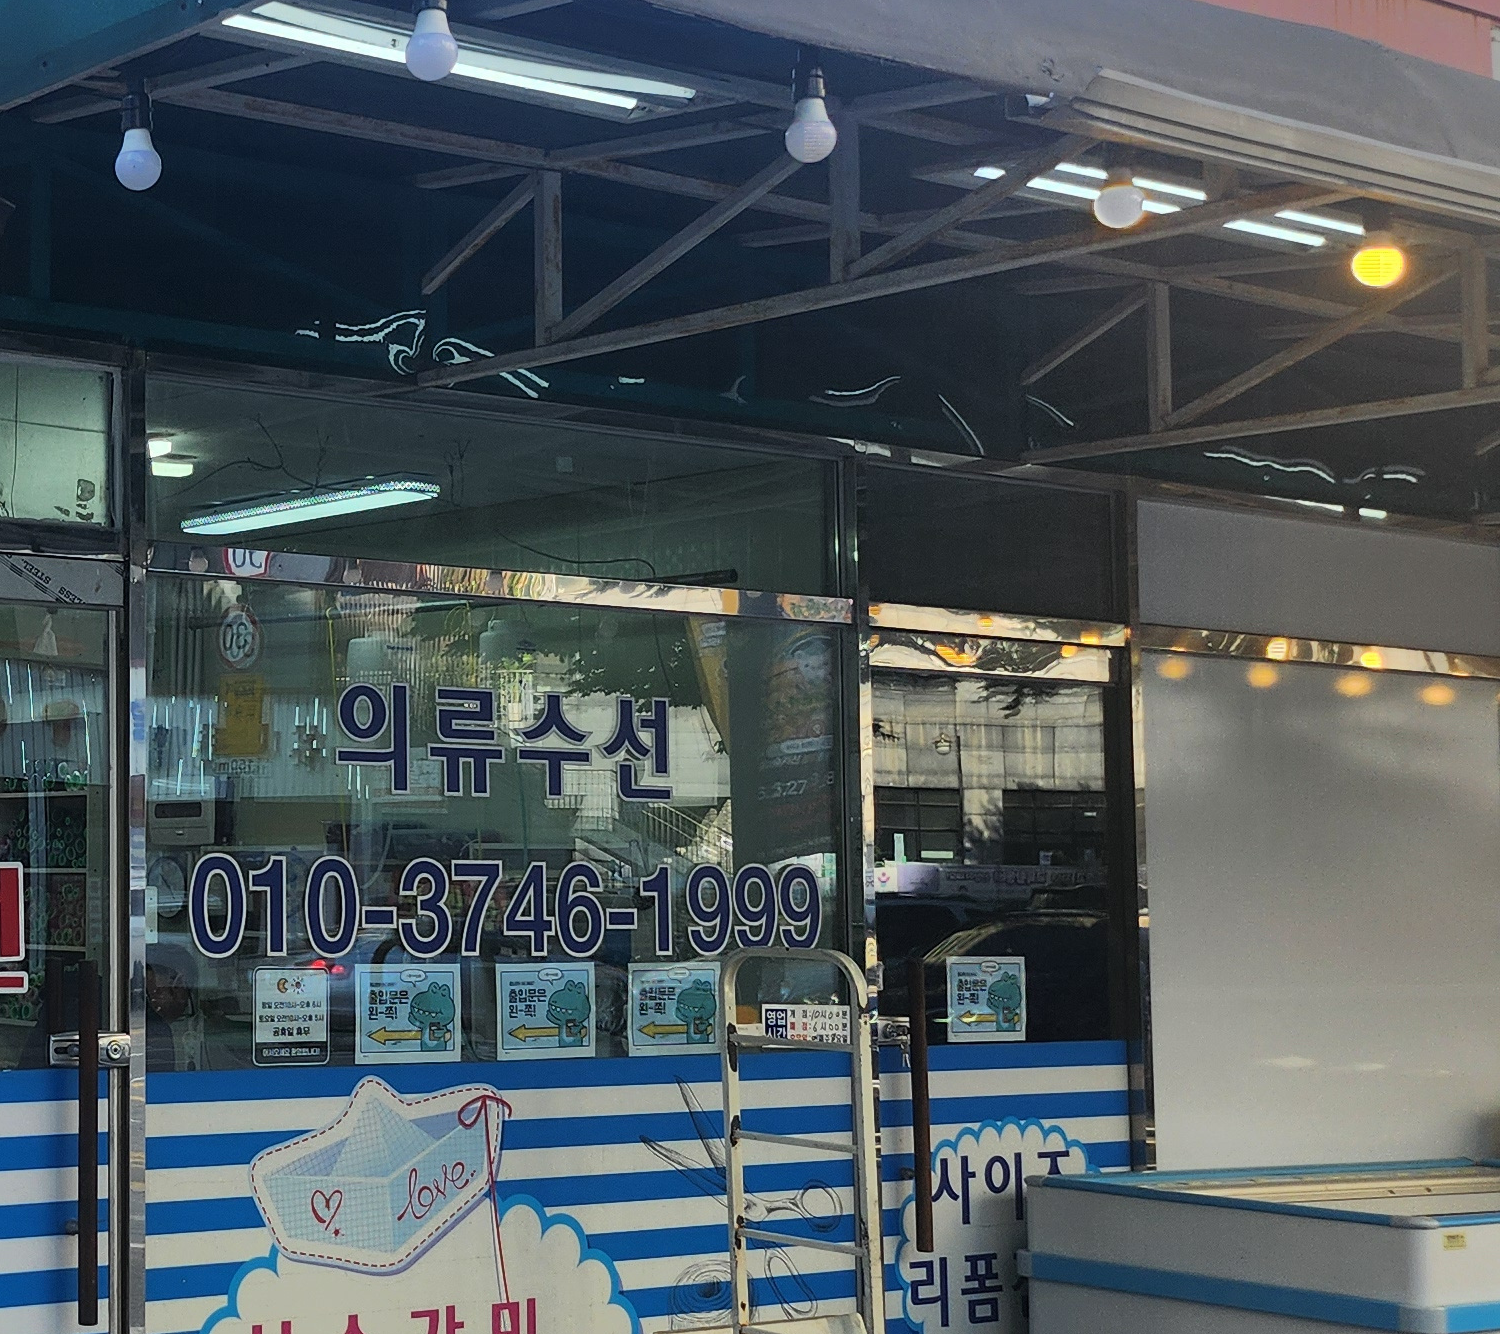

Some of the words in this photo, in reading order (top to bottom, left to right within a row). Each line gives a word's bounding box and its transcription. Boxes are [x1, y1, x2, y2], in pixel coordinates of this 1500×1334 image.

[336, 682, 673, 801] 의류수선
[189, 852, 824, 959] 010-3746-1999
[766, 1010, 787, 1026] 영업
[909, 1252, 1029, 1328] 리폼
